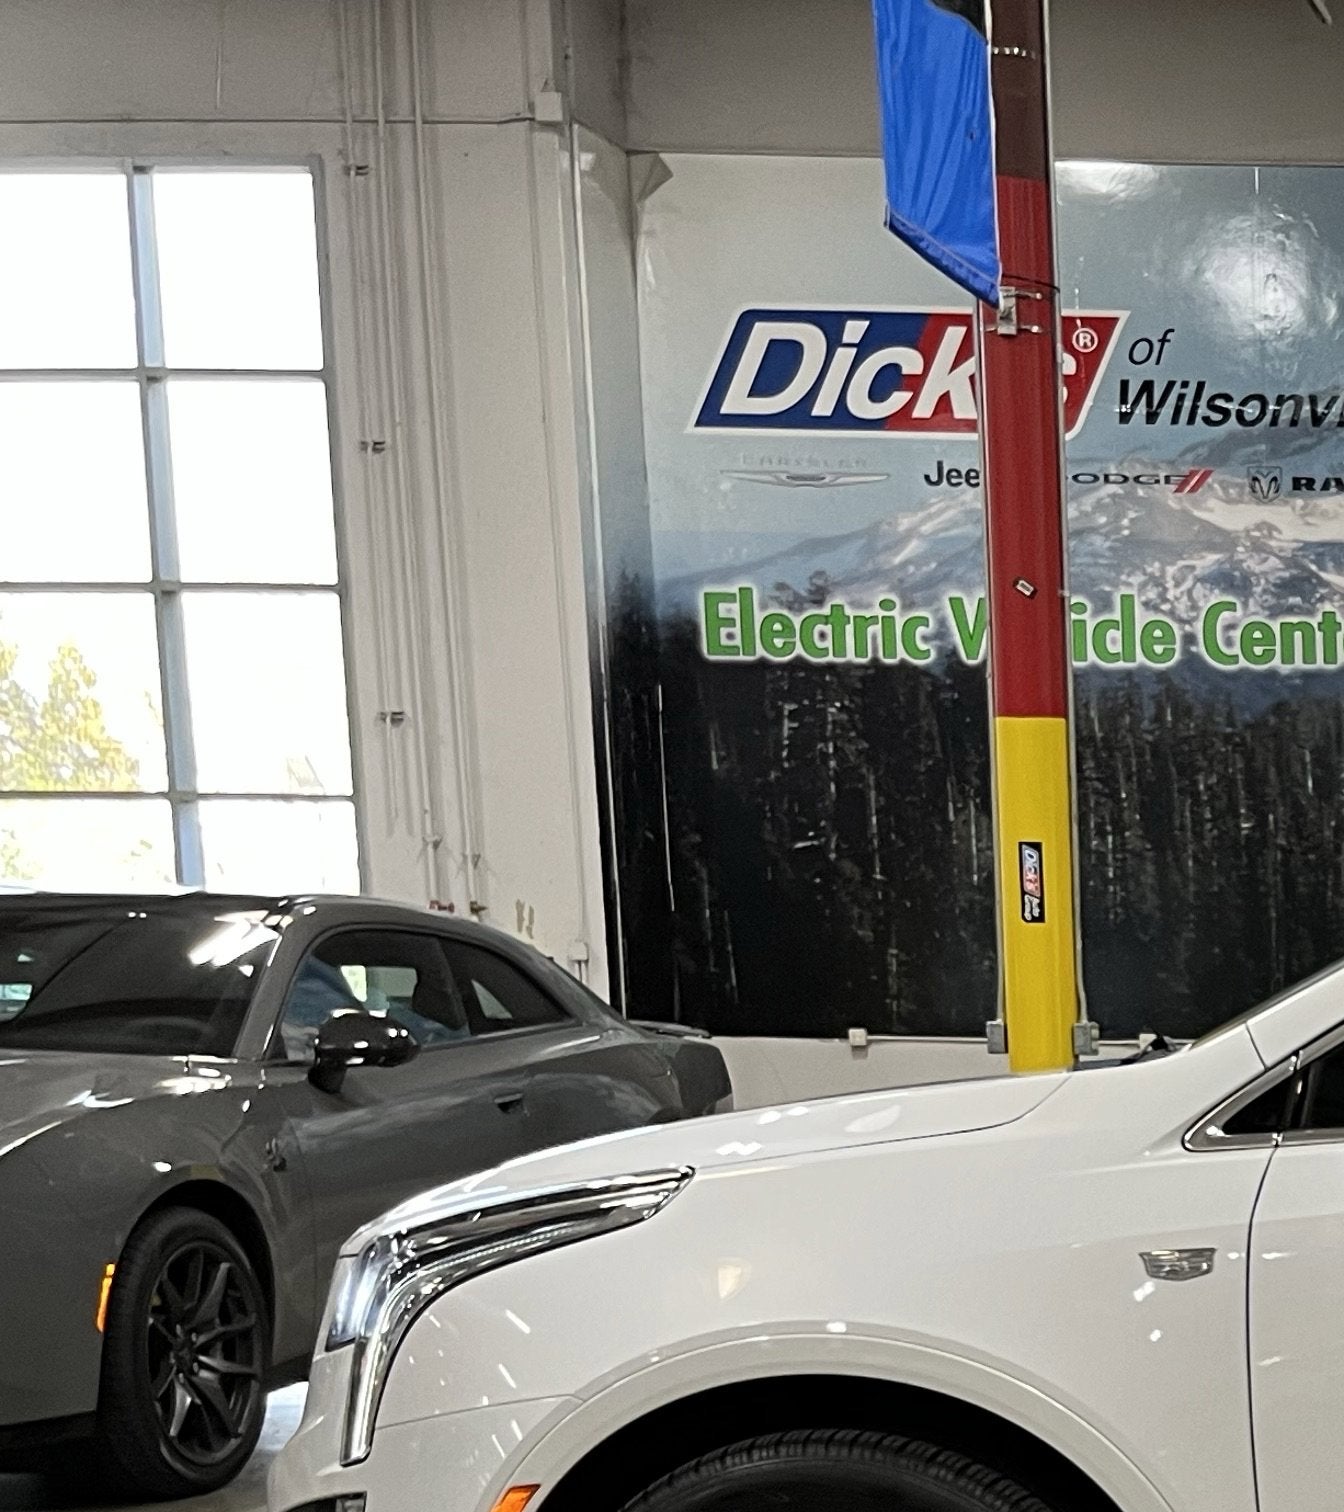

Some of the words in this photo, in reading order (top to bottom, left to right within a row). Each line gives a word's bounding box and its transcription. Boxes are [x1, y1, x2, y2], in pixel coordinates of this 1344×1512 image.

[1128, 328, 1175, 366] of
[924, 460, 980, 488] Jee
[703, 587, 931, 660] Electric
[948, 593, 1176, 664] Vicle
